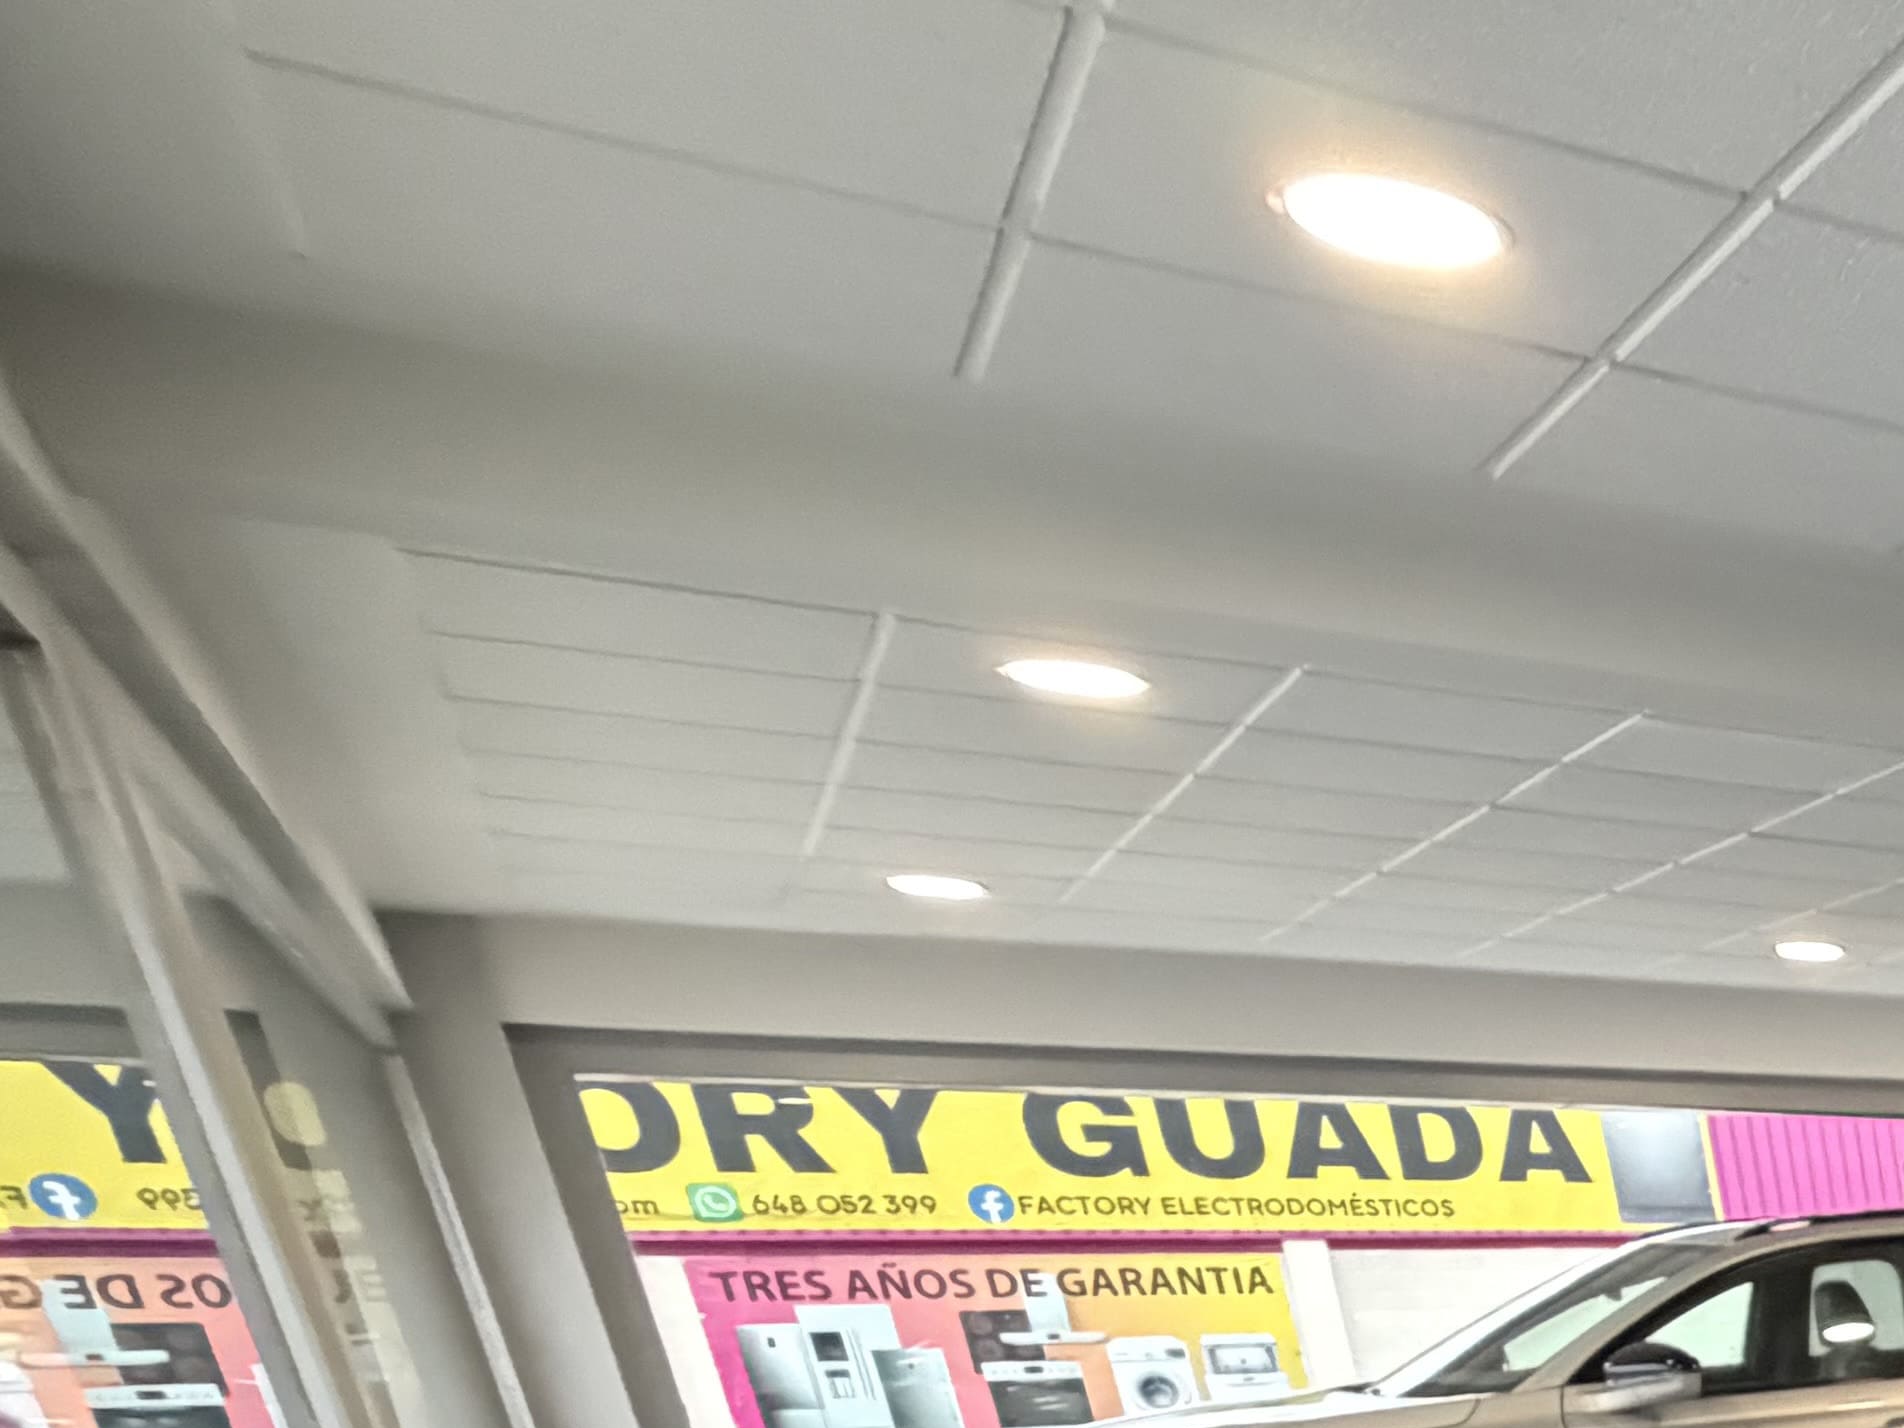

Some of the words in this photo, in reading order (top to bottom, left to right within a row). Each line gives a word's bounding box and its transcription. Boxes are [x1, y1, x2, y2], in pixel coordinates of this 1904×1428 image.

[1022, 1093, 1595, 1183] GUADA
[751, 1194, 808, 1216] 648
[816, 1195, 877, 1215] 052
[884, 1194, 937, 1215] 399
[1017, 1195, 1151, 1216] FACTORY
[1160, 1192, 1456, 1218] ELECTRODOMÉSTICOS
[708, 1270, 833, 1302] TRES
[846, 1262, 977, 1301] AÑOS
[984, 1268, 1048, 1299] DE
[1056, 1266, 1274, 1297] GARANTIA
